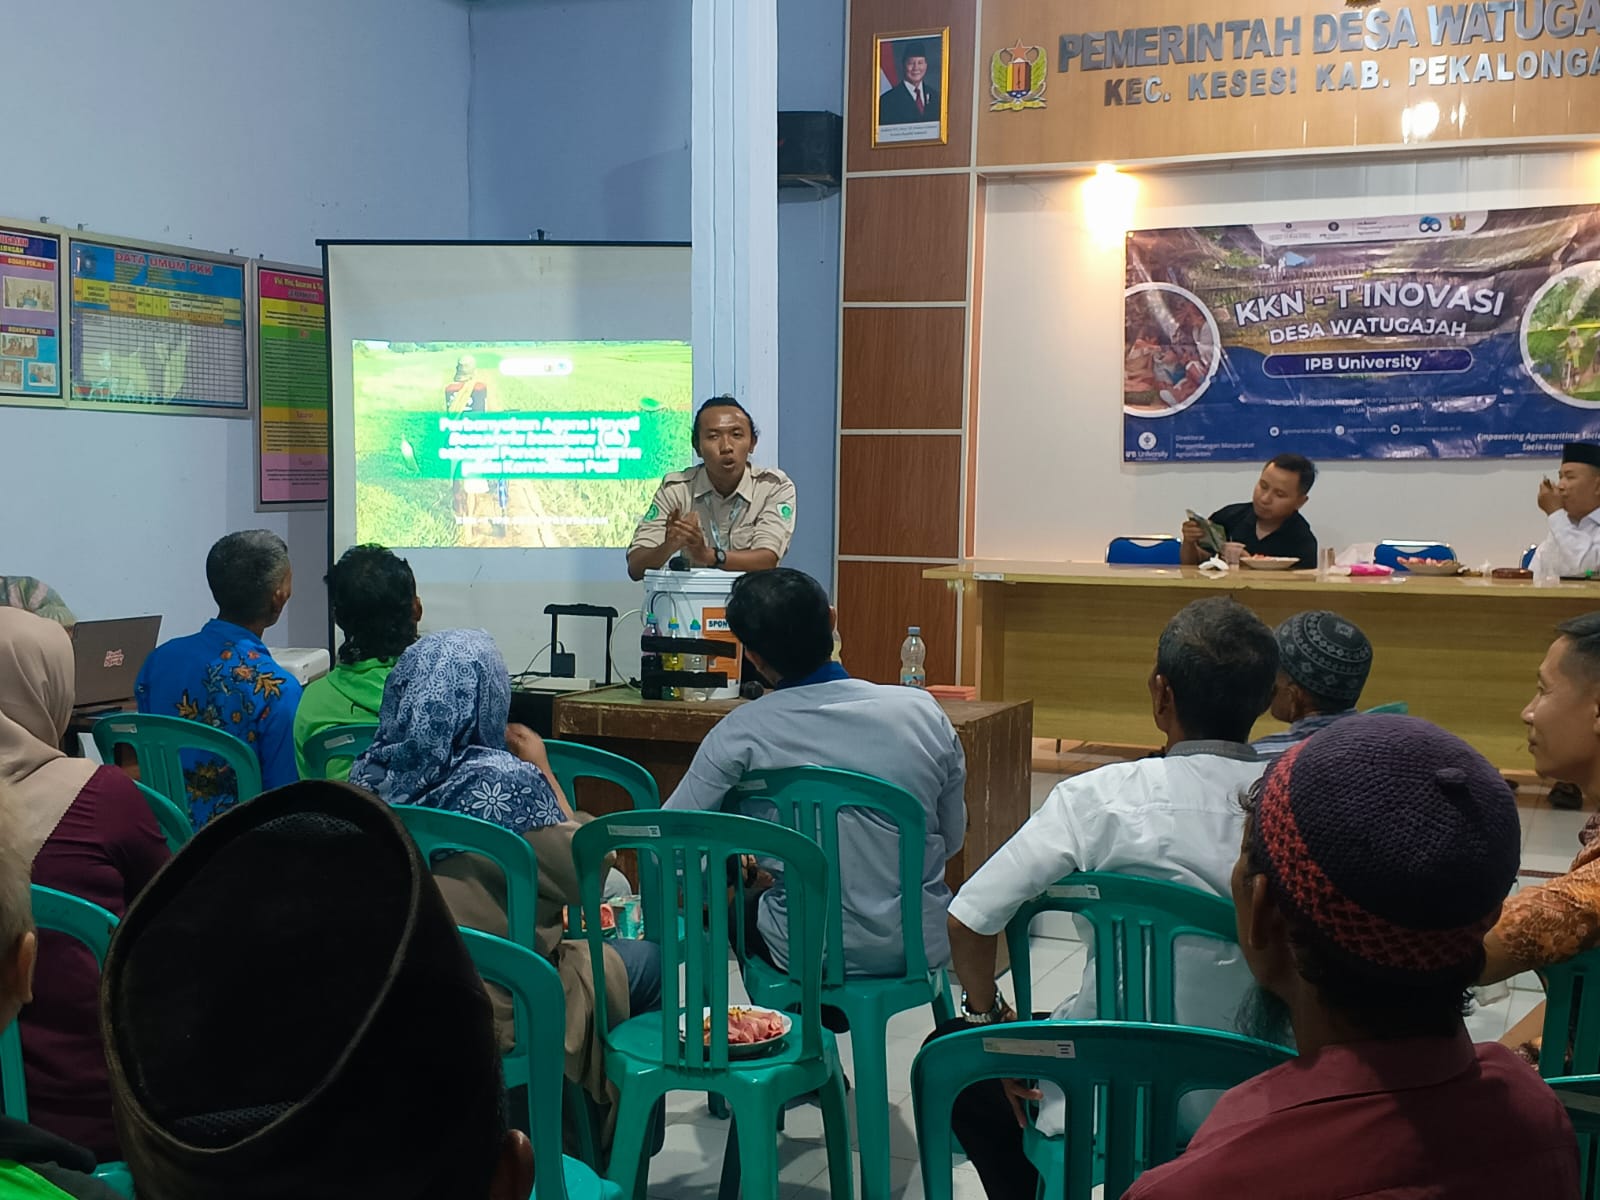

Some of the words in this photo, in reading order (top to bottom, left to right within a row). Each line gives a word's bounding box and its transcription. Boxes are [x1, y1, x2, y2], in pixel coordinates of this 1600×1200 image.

[1057, 15, 1301, 73] PEMERINTAH
[1313, 7, 1419, 54] DESA
[1104, 76, 1171, 107] KEC.
[1188, 66, 1297, 101] KESESI
[1315, 59, 1391, 92] KAB.
[115, 252, 146, 265] DATA
[149, 258, 187, 272] UMUM
[189, 263, 213, 275] PKK
[1235, 290, 1302, 326] KKN
[1332, 284, 1361, 309] T
[1363, 281, 1504, 317] INOVASI
[1269, 325, 1325, 346] DESA
[1329, 316, 1467, 339] WATUGAJAH
[1304, 356, 1334, 372] IPB
[1337, 354, 1422, 373] University
